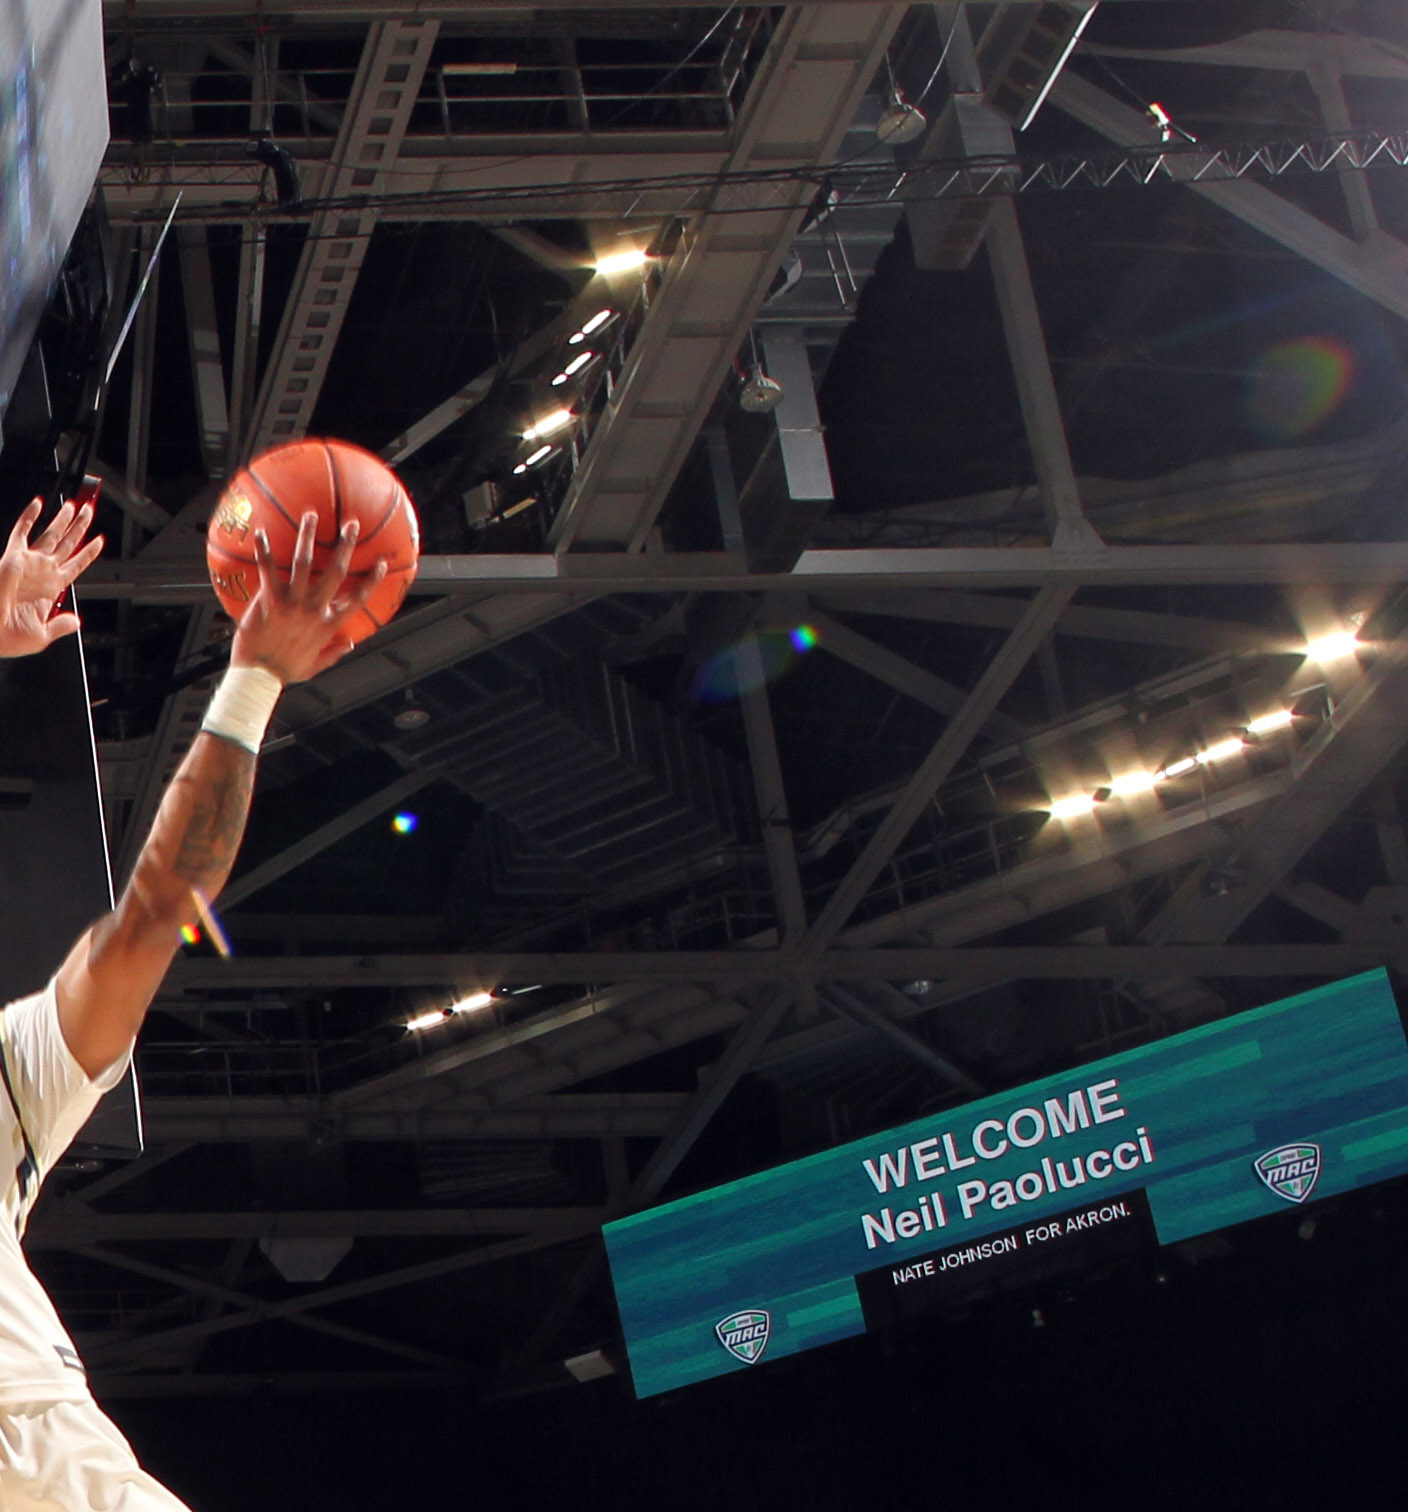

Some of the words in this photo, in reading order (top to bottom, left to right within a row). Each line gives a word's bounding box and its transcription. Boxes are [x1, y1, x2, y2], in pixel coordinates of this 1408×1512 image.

[862, 1079, 1126, 1195] WELCOME
[1267, 1158, 1317, 1184] MAC
[861, 1198, 949, 1250] Neil
[957, 1128, 1156, 1220] Paolucci
[892, 1259, 936, 1286] NATE
[939, 1235, 1018, 1273] JOHNSON
[1026, 1222, 1062, 1246] FOR
[1064, 1202, 1131, 1237] AKRON.
[725, 1324, 767, 1346] MAC
